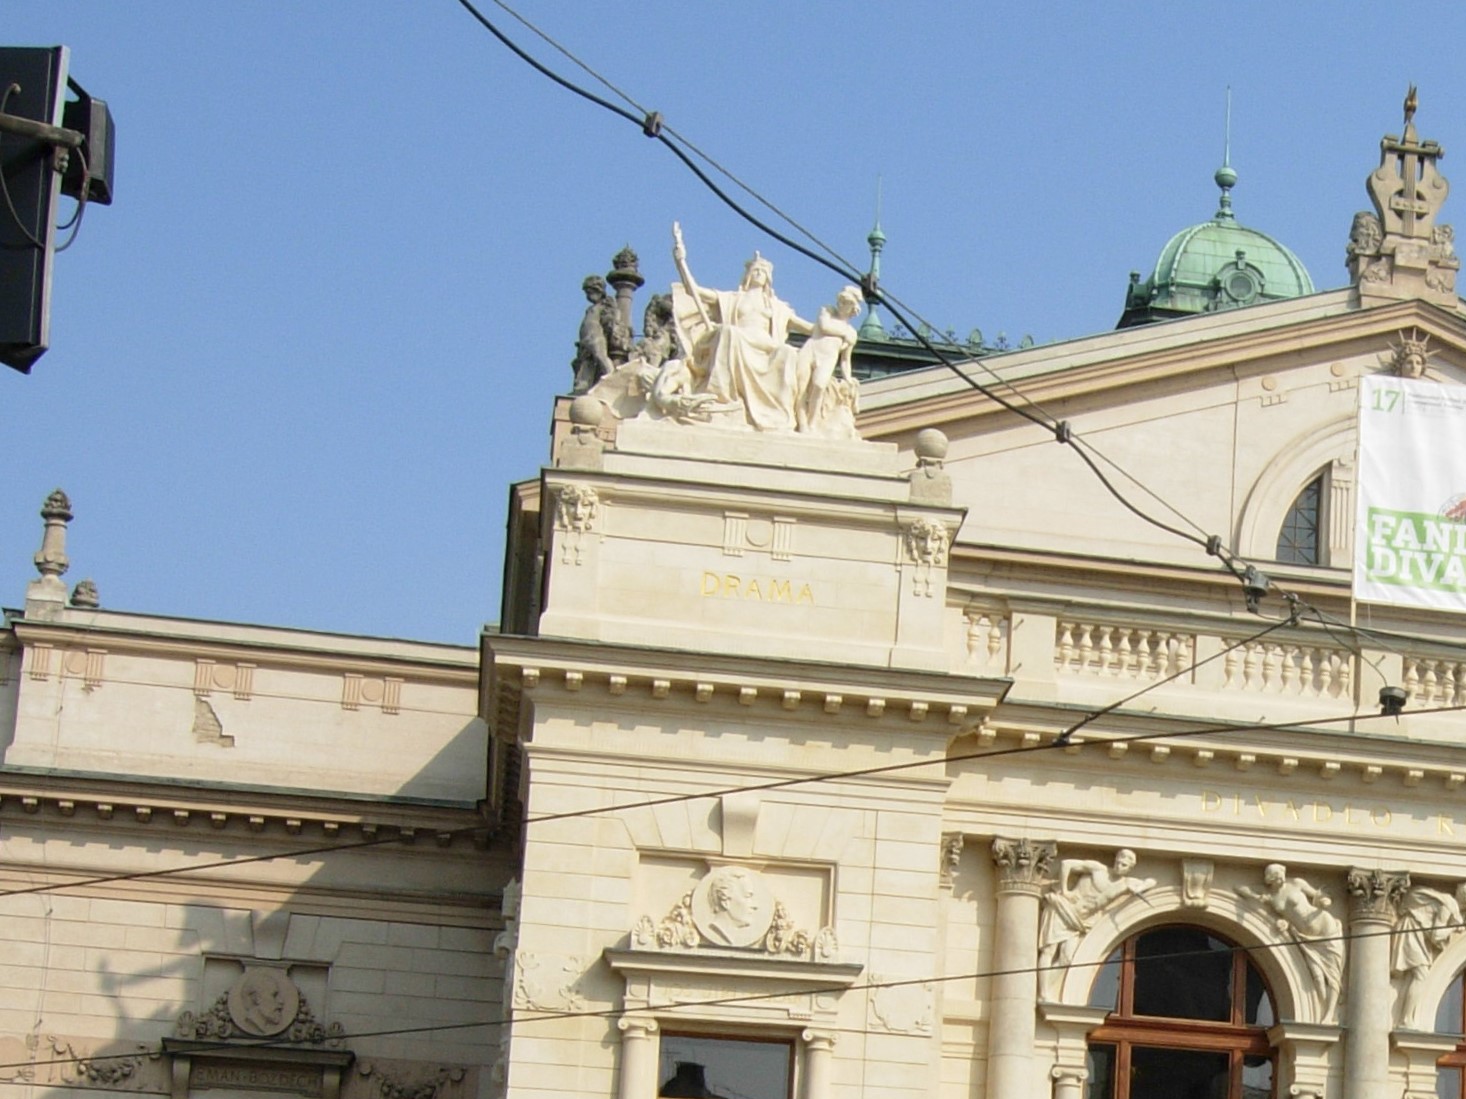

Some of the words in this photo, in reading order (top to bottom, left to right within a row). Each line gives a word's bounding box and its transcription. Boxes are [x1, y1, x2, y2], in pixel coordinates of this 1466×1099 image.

[1371, 388, 1400, 413] 17
[701, 570, 815, 605] DRAMA
[1201, 789, 1392, 828] DIVADLO
